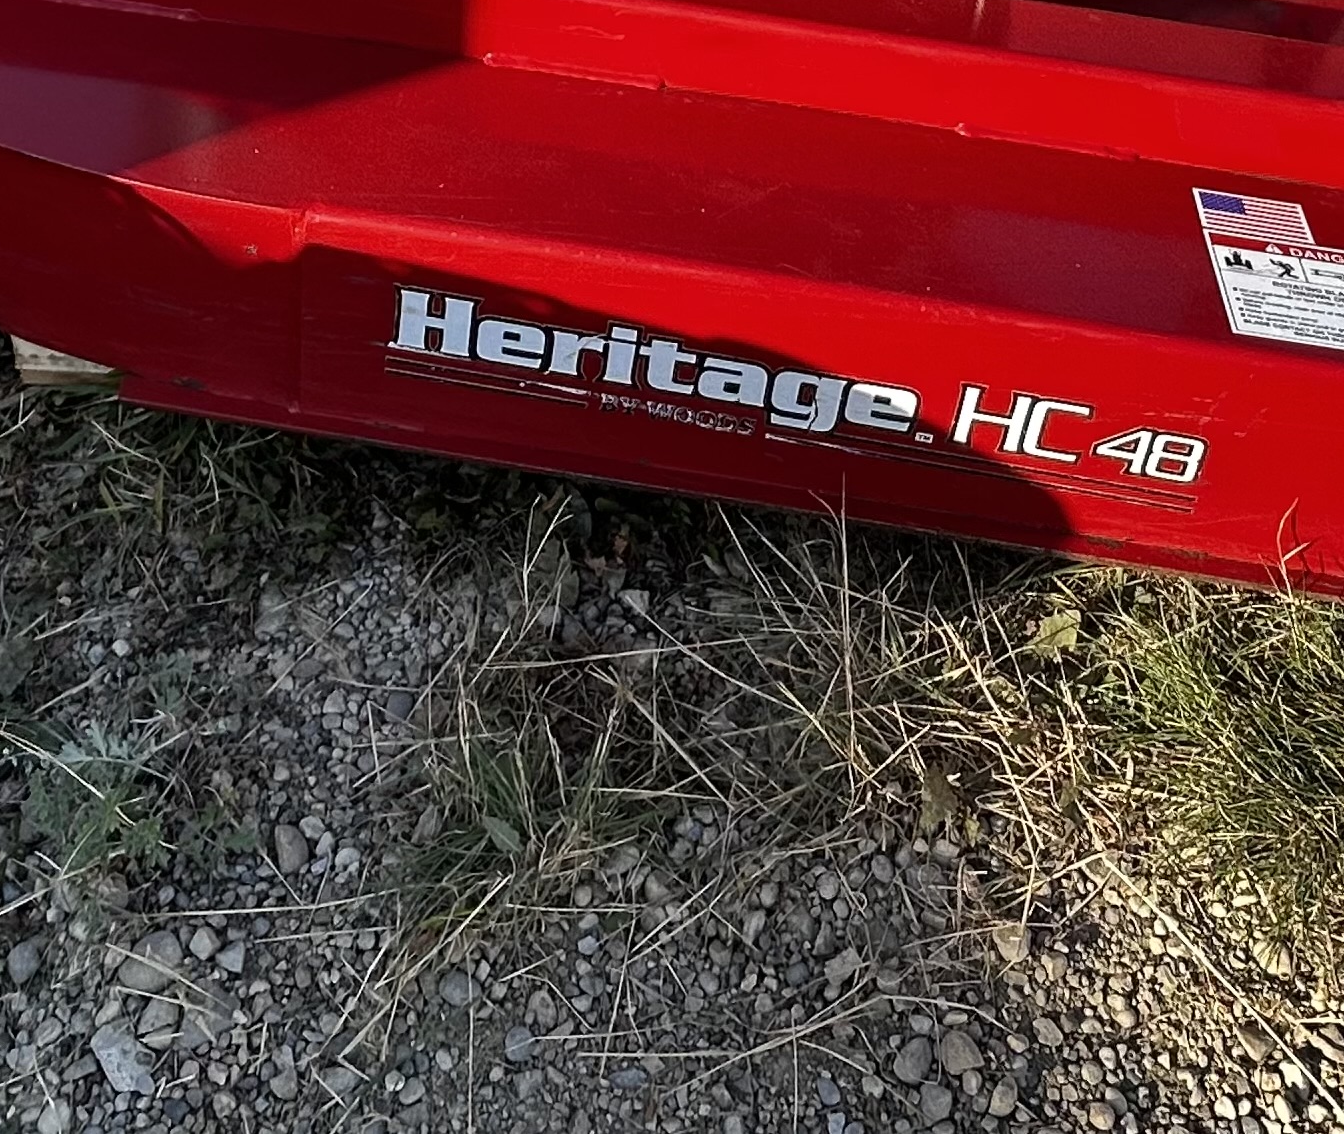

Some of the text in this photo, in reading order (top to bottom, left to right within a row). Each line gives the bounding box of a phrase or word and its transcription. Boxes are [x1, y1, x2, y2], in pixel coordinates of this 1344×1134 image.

[390, 287, 919, 433] Heritage
[951, 384, 1094, 464] HC
[1094, 426, 1207, 483] 48
[646, 400, 758, 436] WOODS
